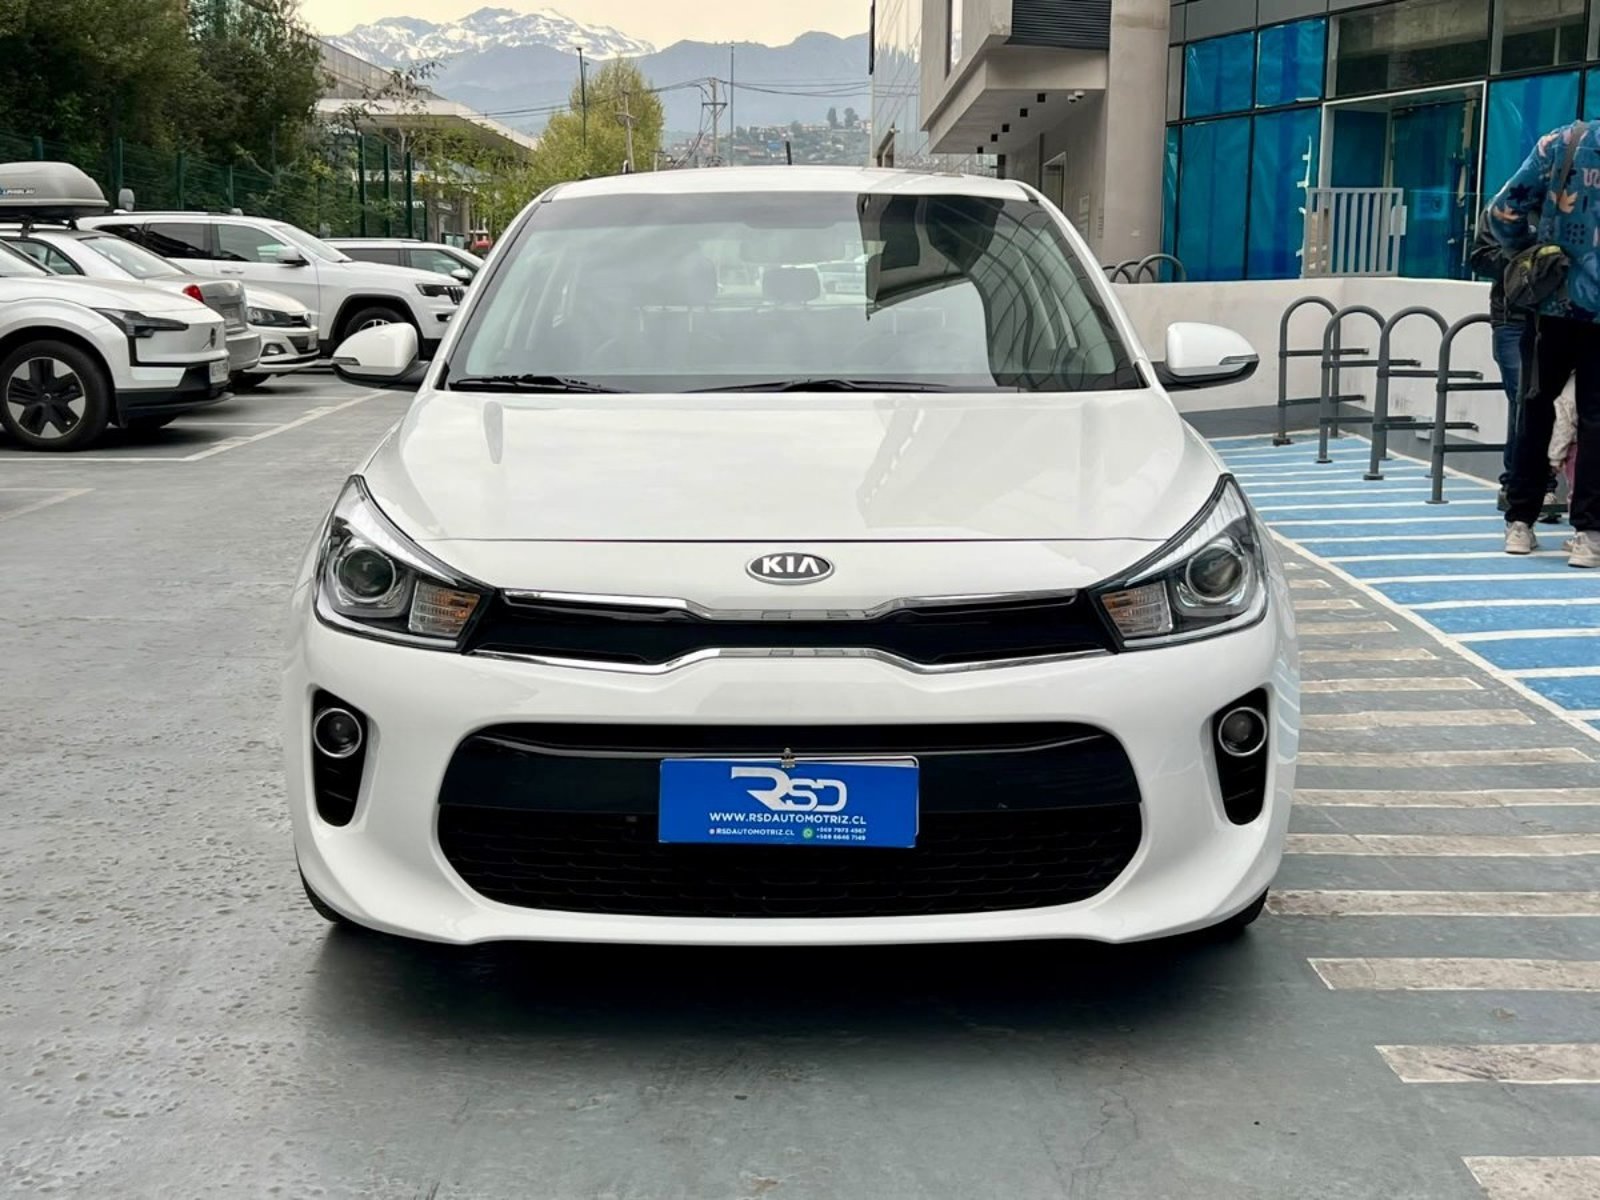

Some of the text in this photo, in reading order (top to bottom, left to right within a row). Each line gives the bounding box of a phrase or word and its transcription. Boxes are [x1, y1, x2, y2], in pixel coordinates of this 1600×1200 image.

[762, 556, 820, 574] KIA
[731, 766, 848, 812] RSD
[709, 812, 867, 825] WWW.RSDAUTOMOTRIZ.CL
